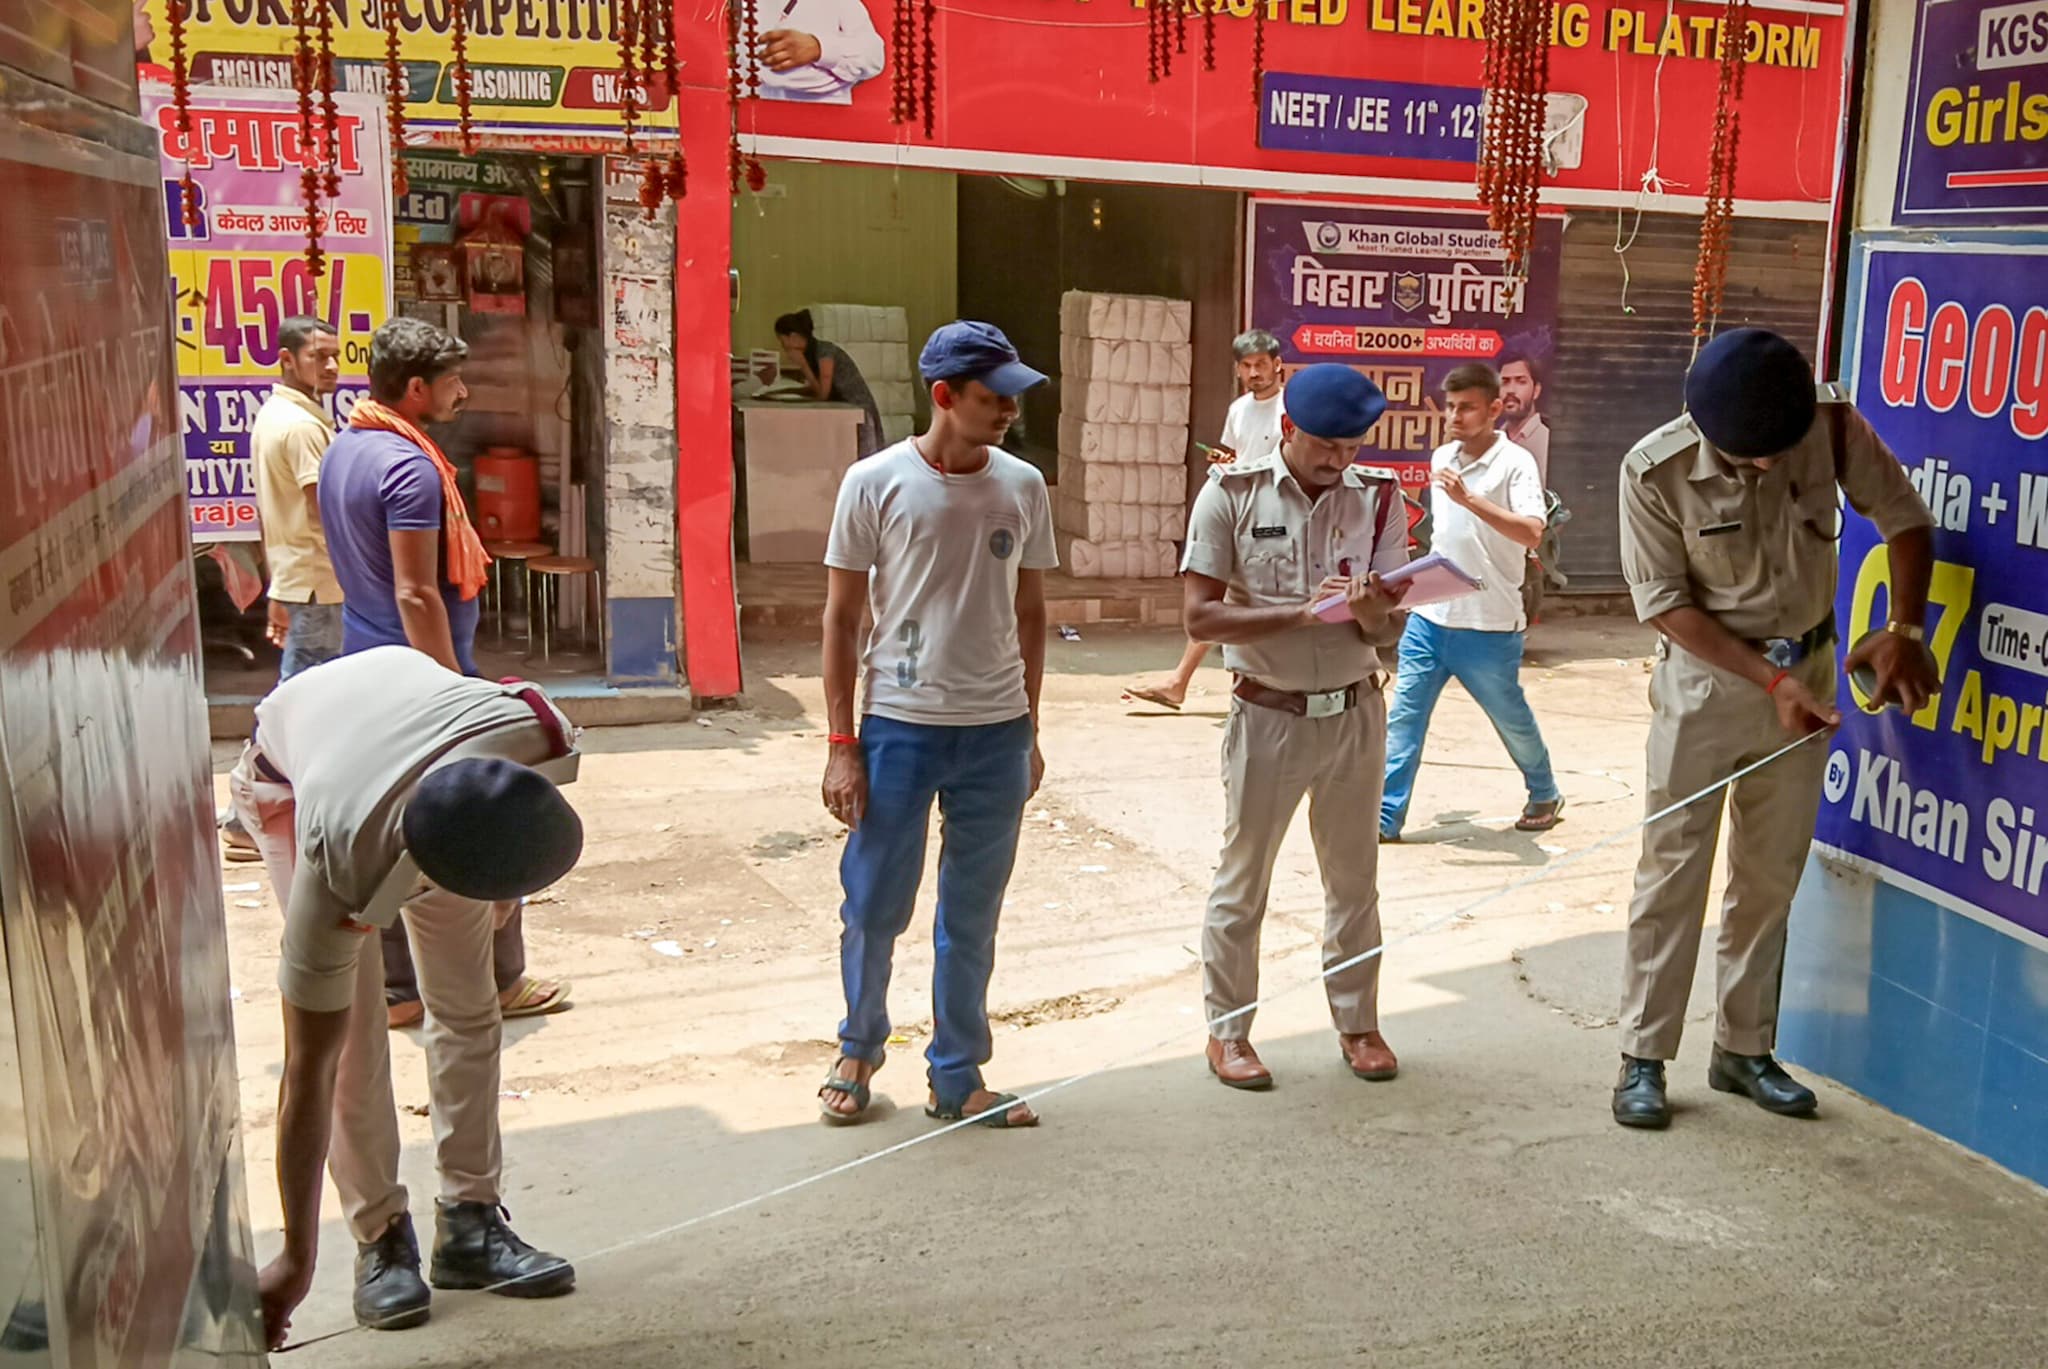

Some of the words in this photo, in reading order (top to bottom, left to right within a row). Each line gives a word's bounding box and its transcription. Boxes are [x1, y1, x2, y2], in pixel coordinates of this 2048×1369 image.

[1986, 11, 2048, 59] KGS
[211, 59, 293, 88] ENGLISH
[1270, 90, 1330, 128] NEET
[1347, 97, 1390, 133] JEE
[1926, 81, 2048, 147] Girls
[217, 209, 264, 231] केवल
[335, 210, 367, 235] लिए
[1348, 229, 1389, 244] Khan
[1394, 231, 1444, 246] Global
[1447, 233, 1504, 249] Studies
[1291, 256, 1389, 309] बिहार
[1428, 262, 1528, 325] पुलिस
[1302, 331, 1311, 346] में
[1356, 332, 1423, 349] 12000+
[1479, 337, 1494, 351] का
[208, 440, 235, 455] या
[1987, 613, 2030, 661] Time
[1828, 761, 1846, 791] By
[1850, 748, 1969, 864] Khan
[1982, 798, 2048, 896] Sir
